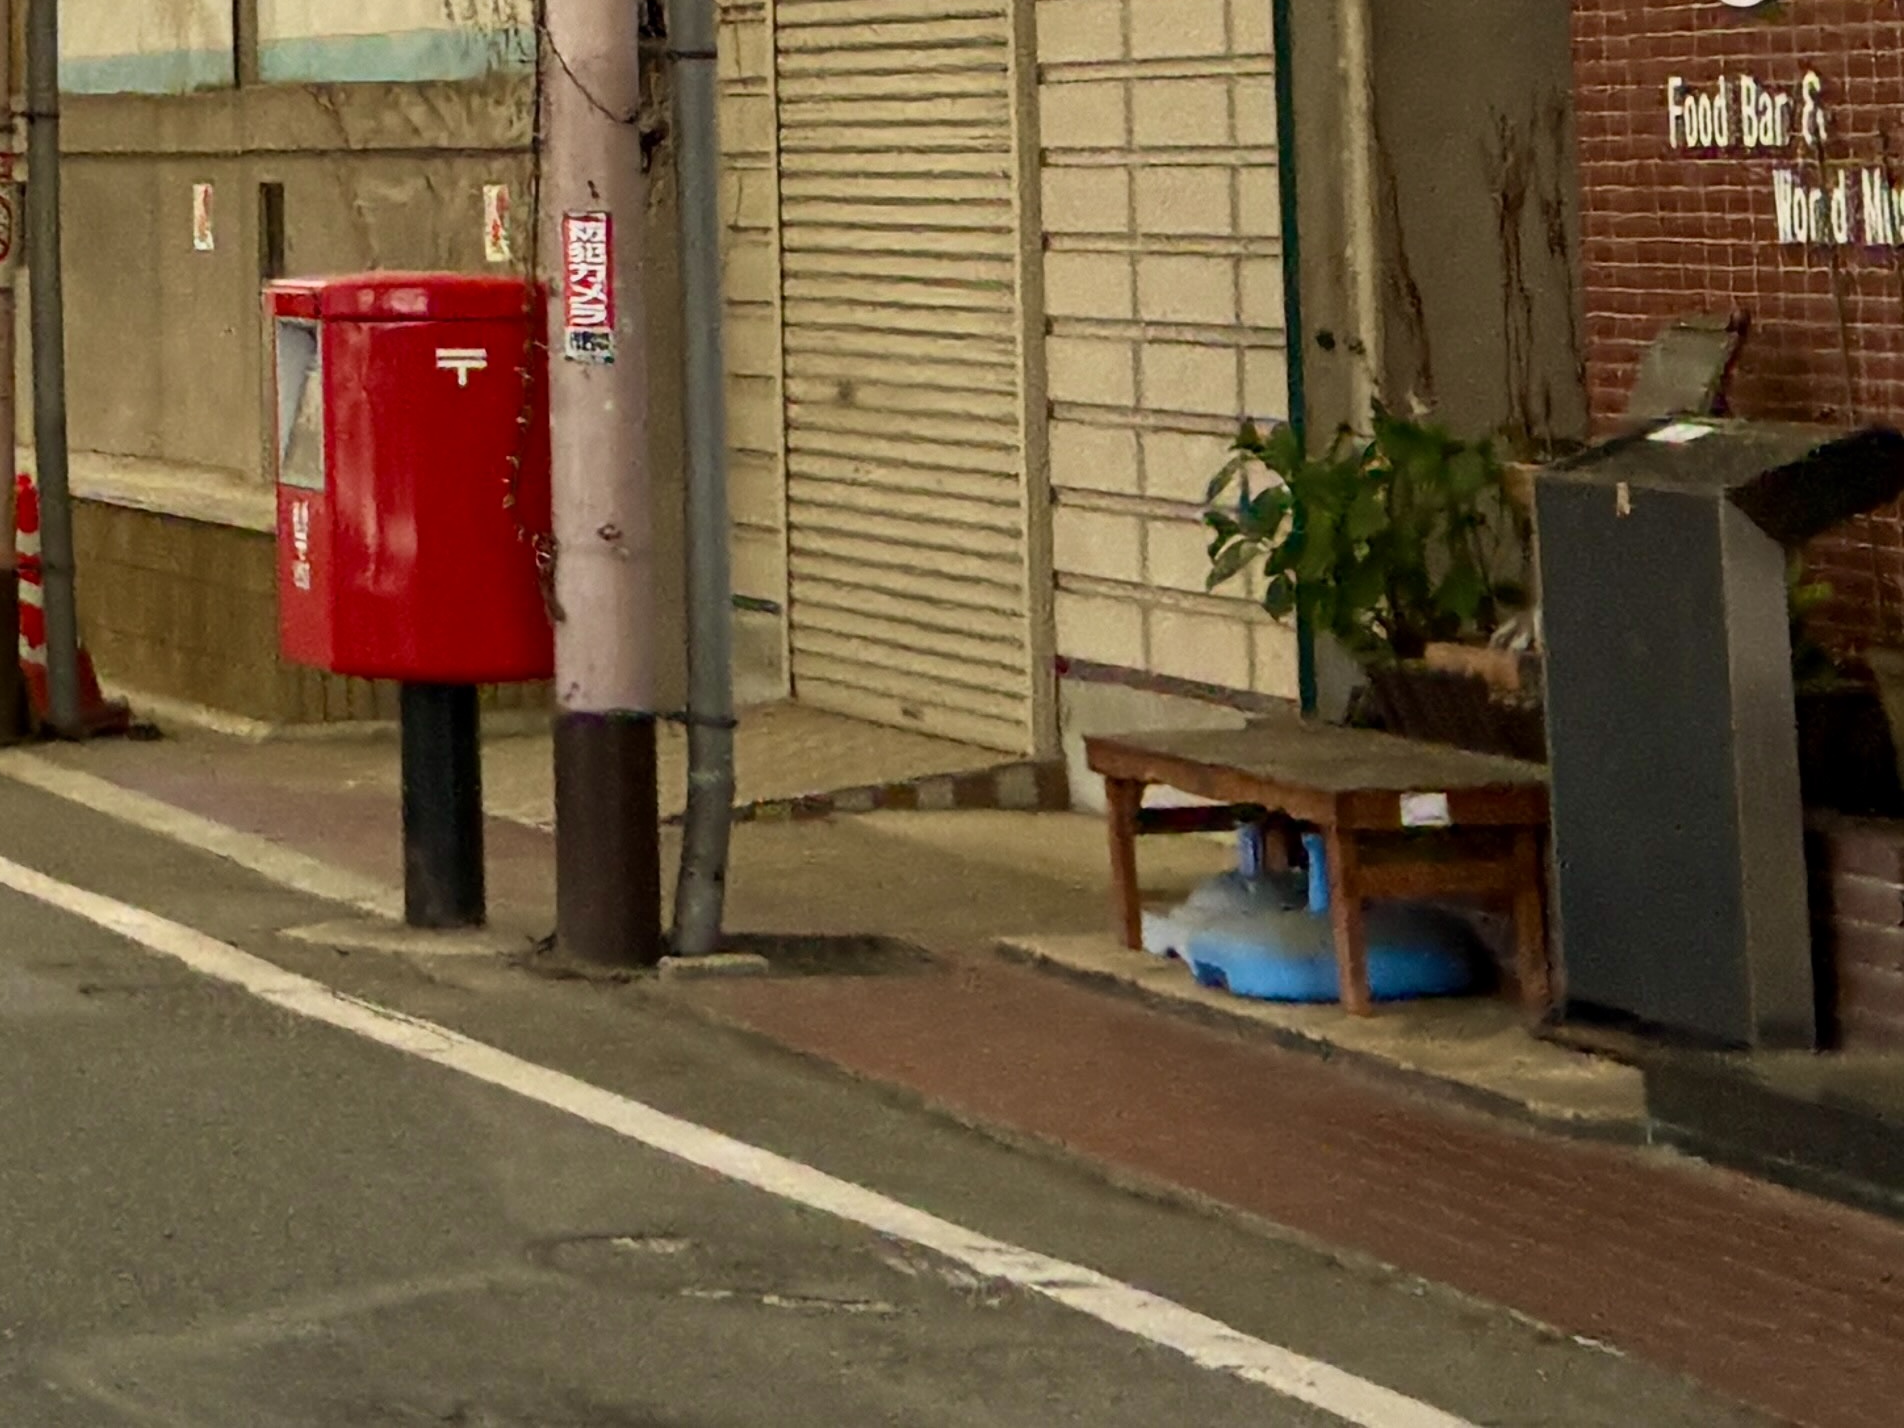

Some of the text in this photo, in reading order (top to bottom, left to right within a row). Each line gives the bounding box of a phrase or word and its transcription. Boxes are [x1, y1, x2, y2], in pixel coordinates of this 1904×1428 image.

[1667, 70, 1828, 149] Food Bar &
[1772, 166, 1904, 246] Word Mu
